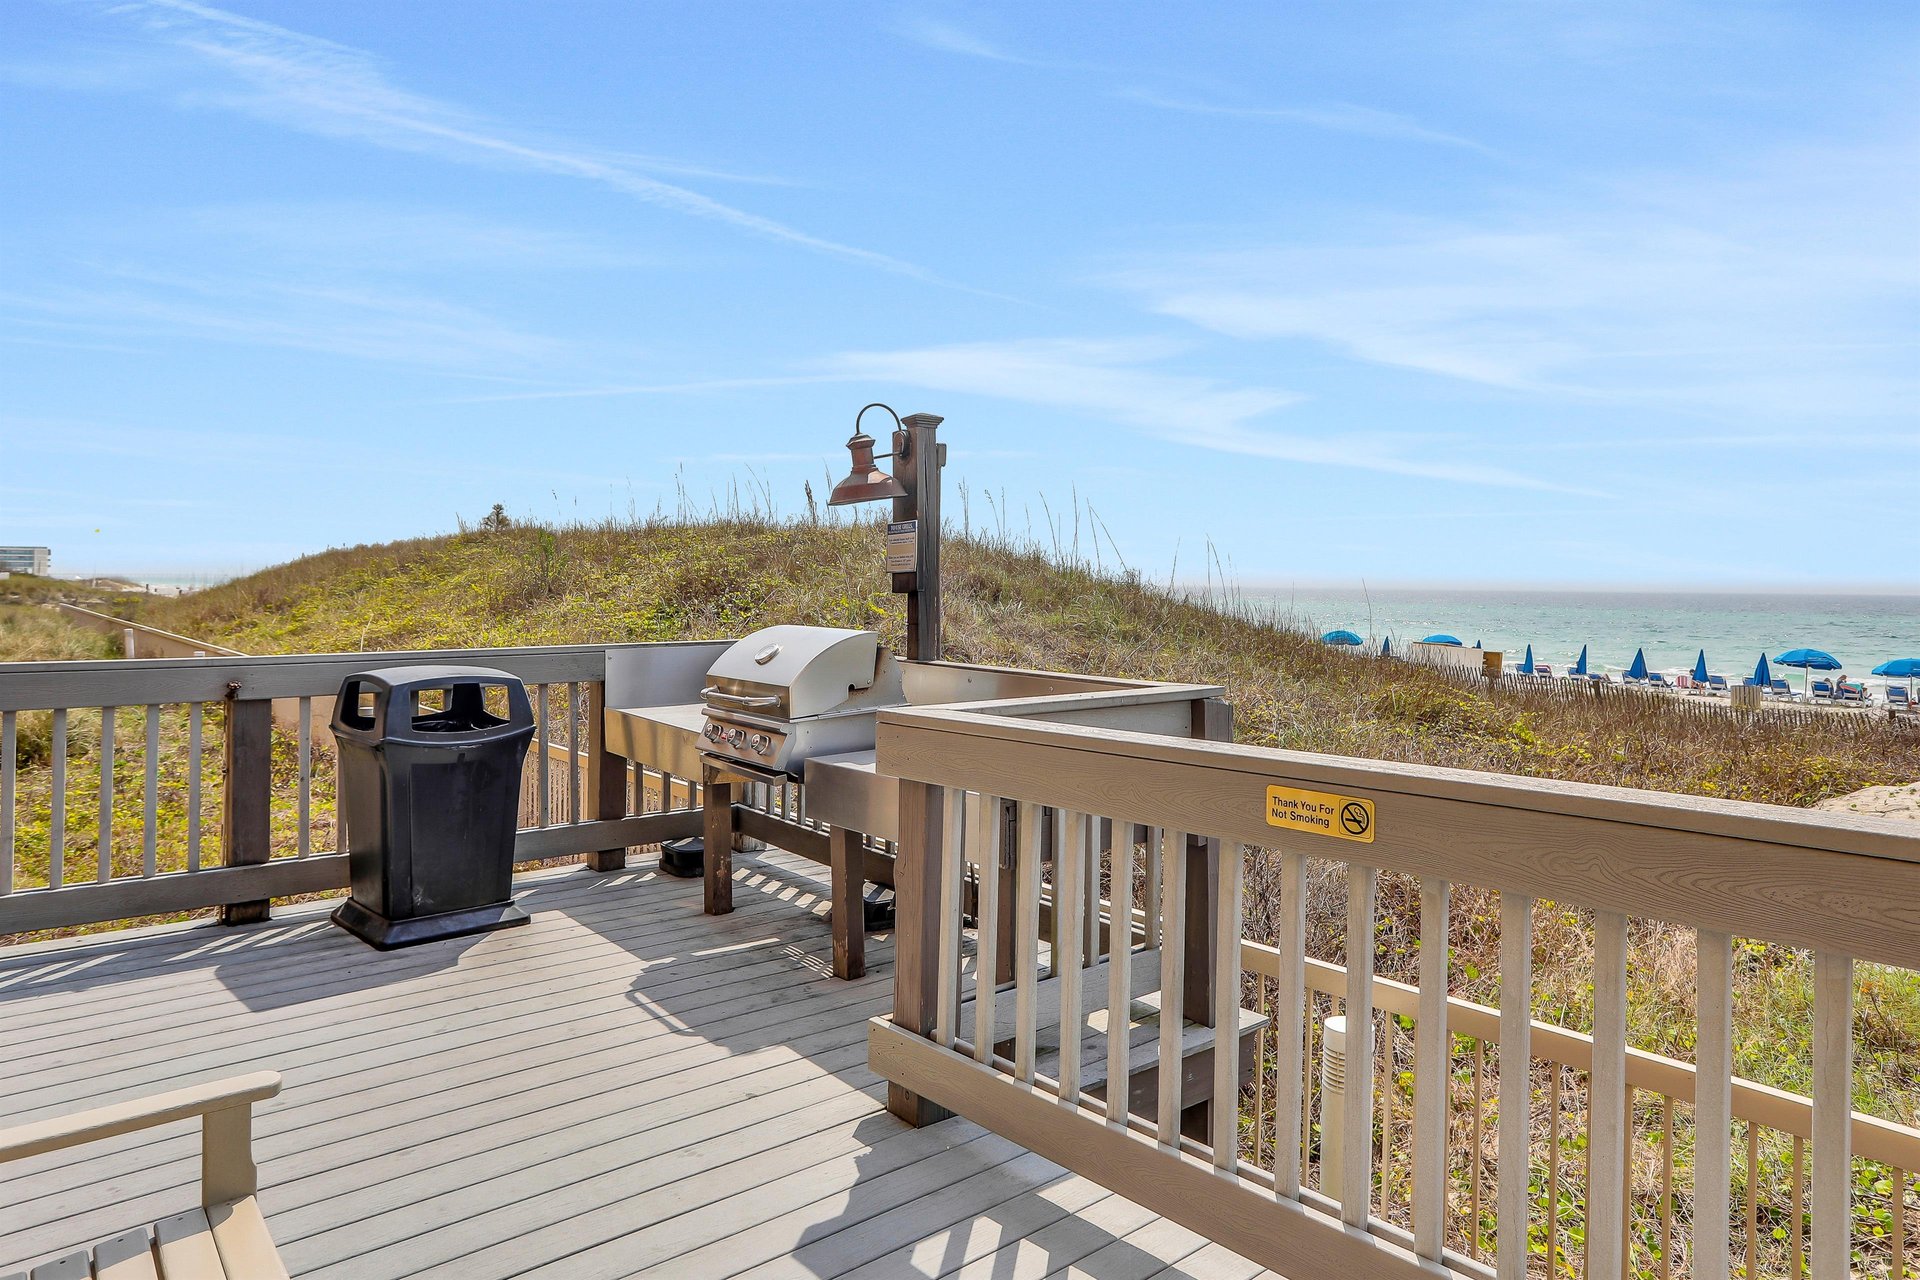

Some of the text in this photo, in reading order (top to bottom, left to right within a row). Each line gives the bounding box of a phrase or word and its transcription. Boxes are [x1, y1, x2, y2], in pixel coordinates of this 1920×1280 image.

[1272, 796, 1335, 816] Thank You For
[1271, 808, 1330, 829] Not Smoking
